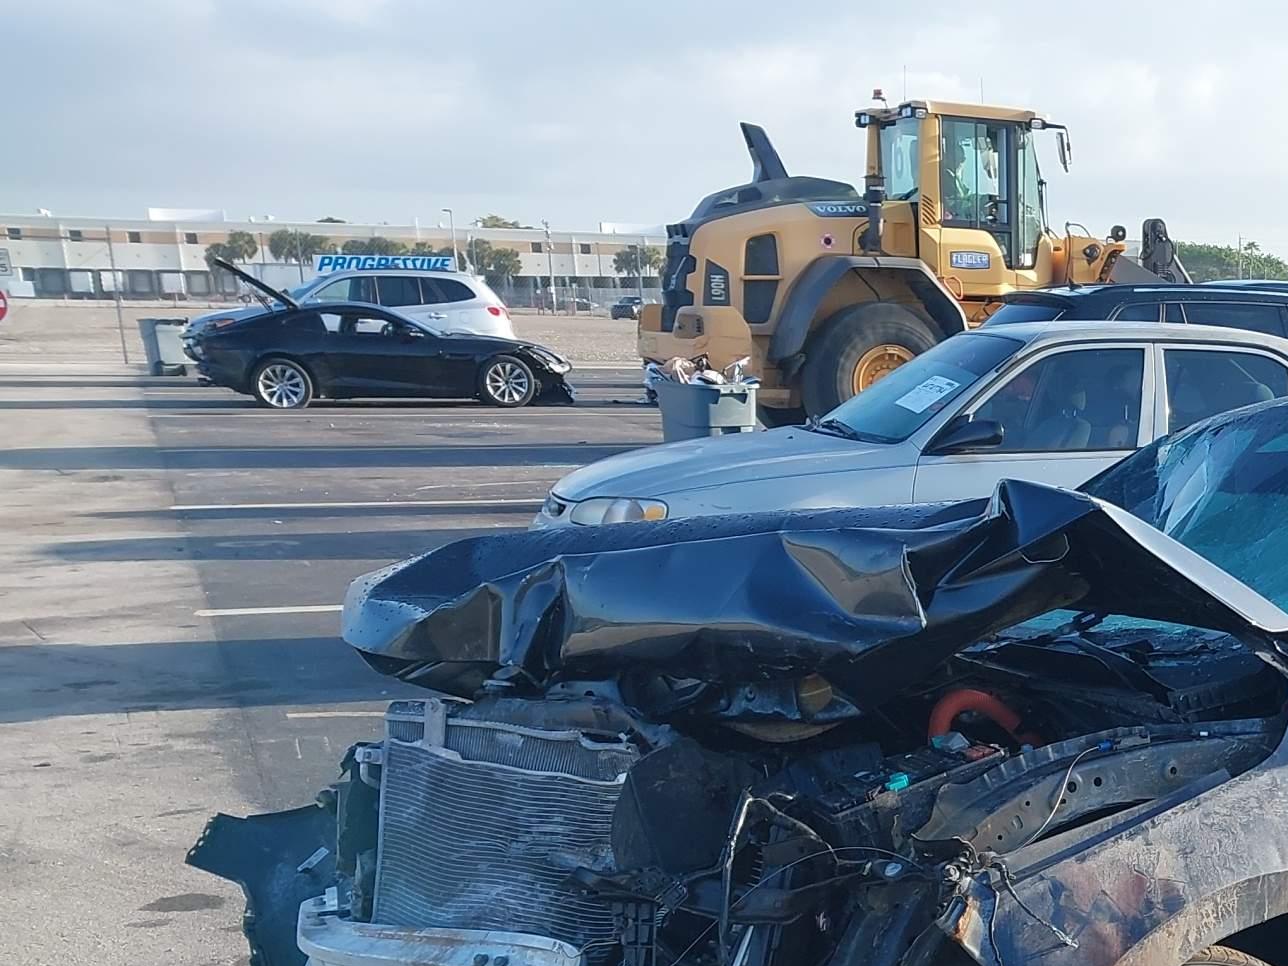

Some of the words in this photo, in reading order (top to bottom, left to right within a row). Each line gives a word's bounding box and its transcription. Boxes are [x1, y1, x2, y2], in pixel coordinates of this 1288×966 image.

[815, 205, 867, 213] VOLVO
[318, 255, 450, 272] PROGRESSIVE
[952, 254, 987, 264] FLAGLER
[710, 274, 725, 300] L90H
